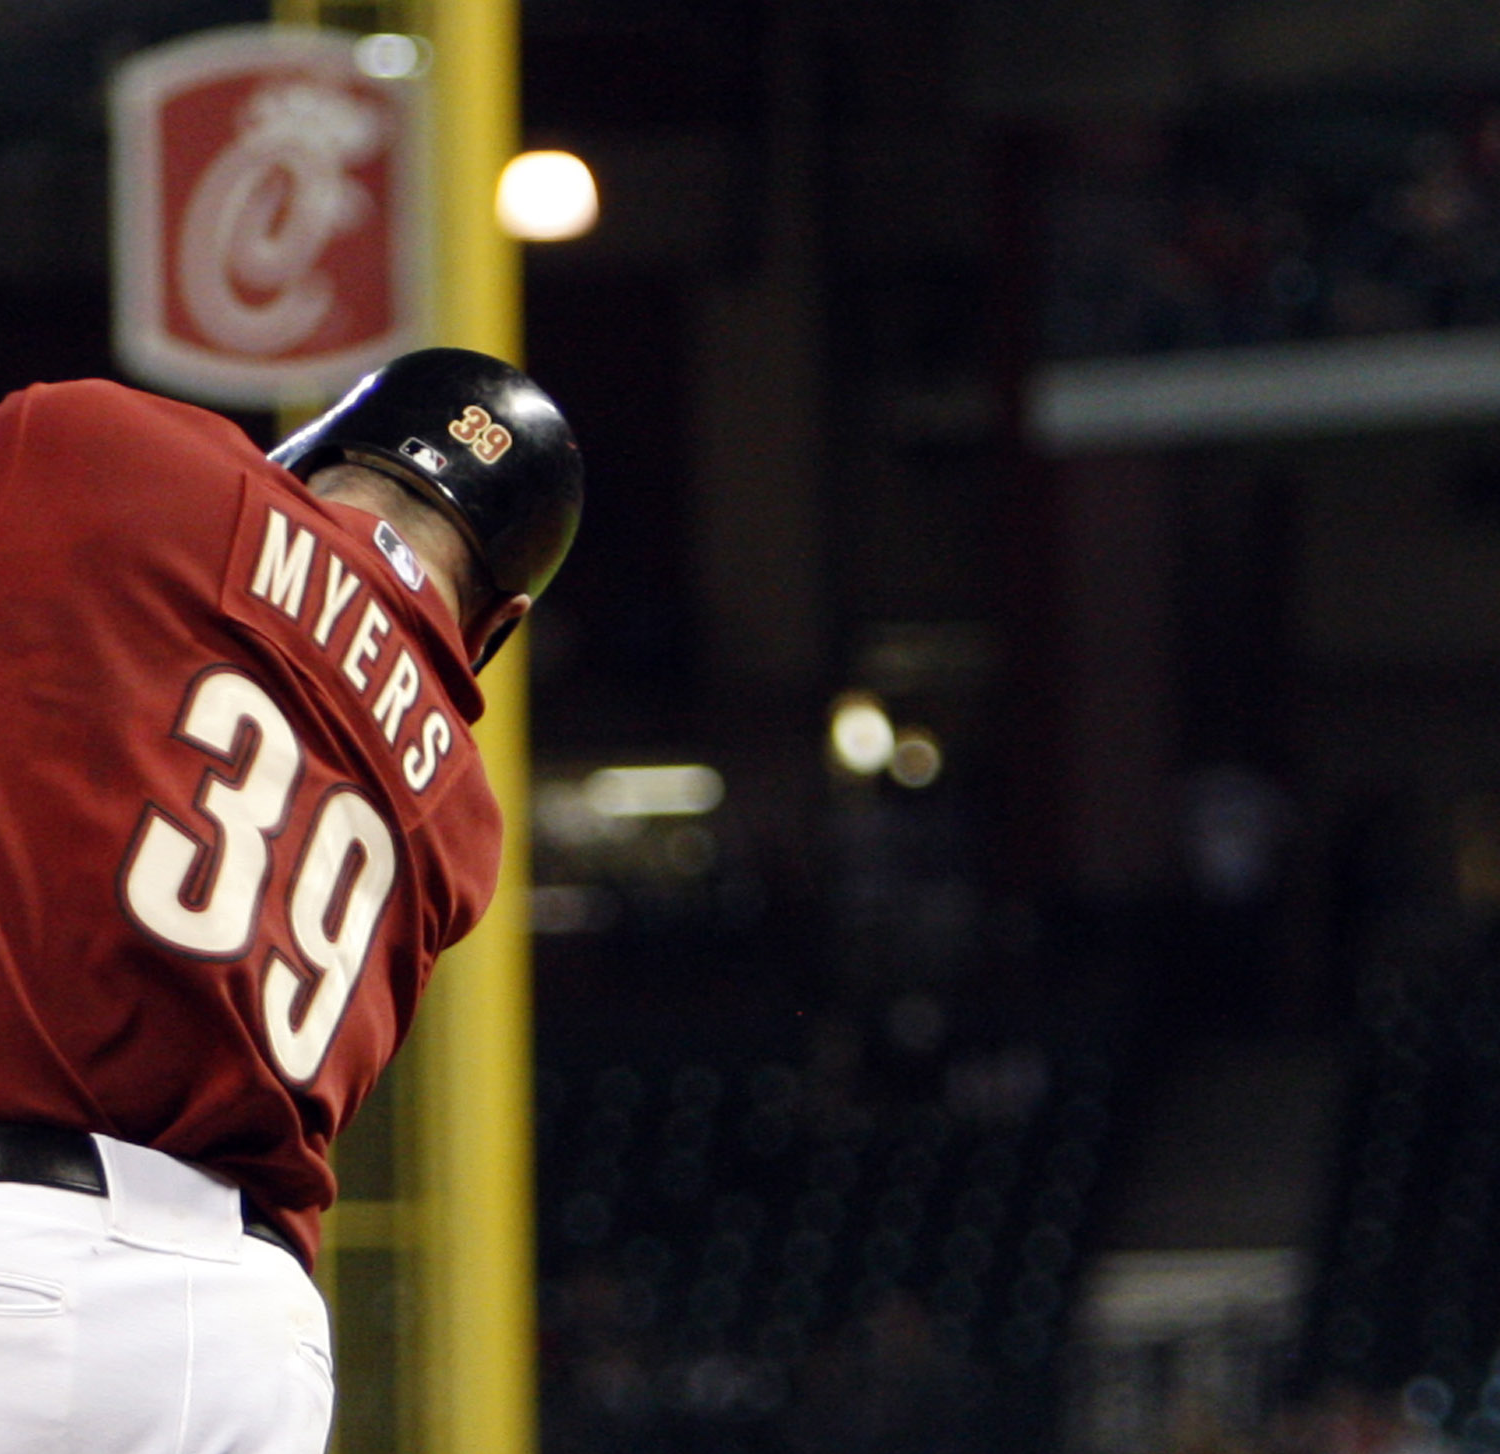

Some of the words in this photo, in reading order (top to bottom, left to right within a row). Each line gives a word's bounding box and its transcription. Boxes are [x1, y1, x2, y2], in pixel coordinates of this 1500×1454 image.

[448, 404, 513, 465] 39
[248, 506, 453, 793] MYERS
[115, 662, 397, 1085] 39
